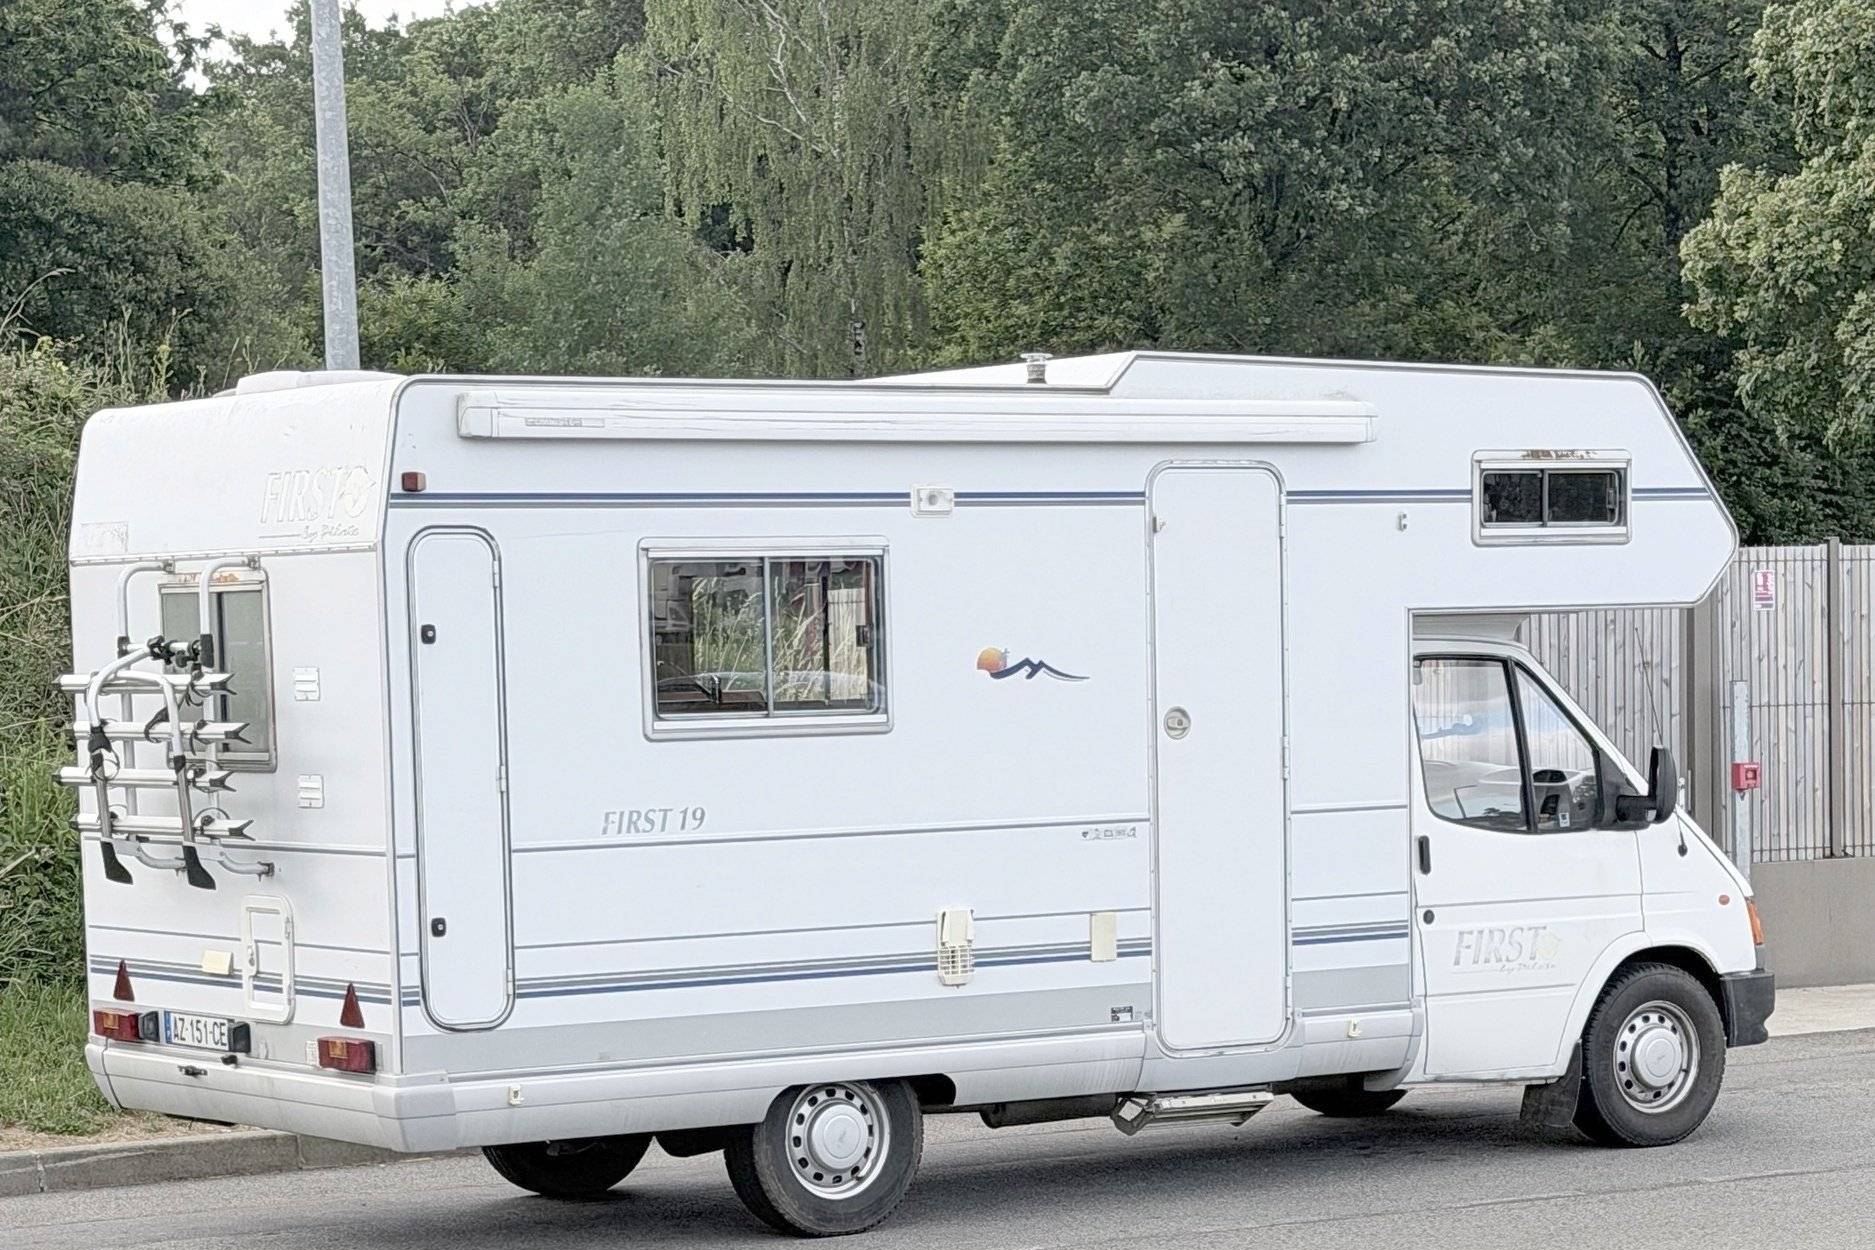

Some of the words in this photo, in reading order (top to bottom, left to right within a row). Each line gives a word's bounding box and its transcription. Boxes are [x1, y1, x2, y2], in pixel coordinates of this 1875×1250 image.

[260, 466, 351, 523] FIRST
[601, 808, 673, 835] FIRST
[678, 806, 706, 831] 19
[1453, 925, 1548, 966] FIRST
